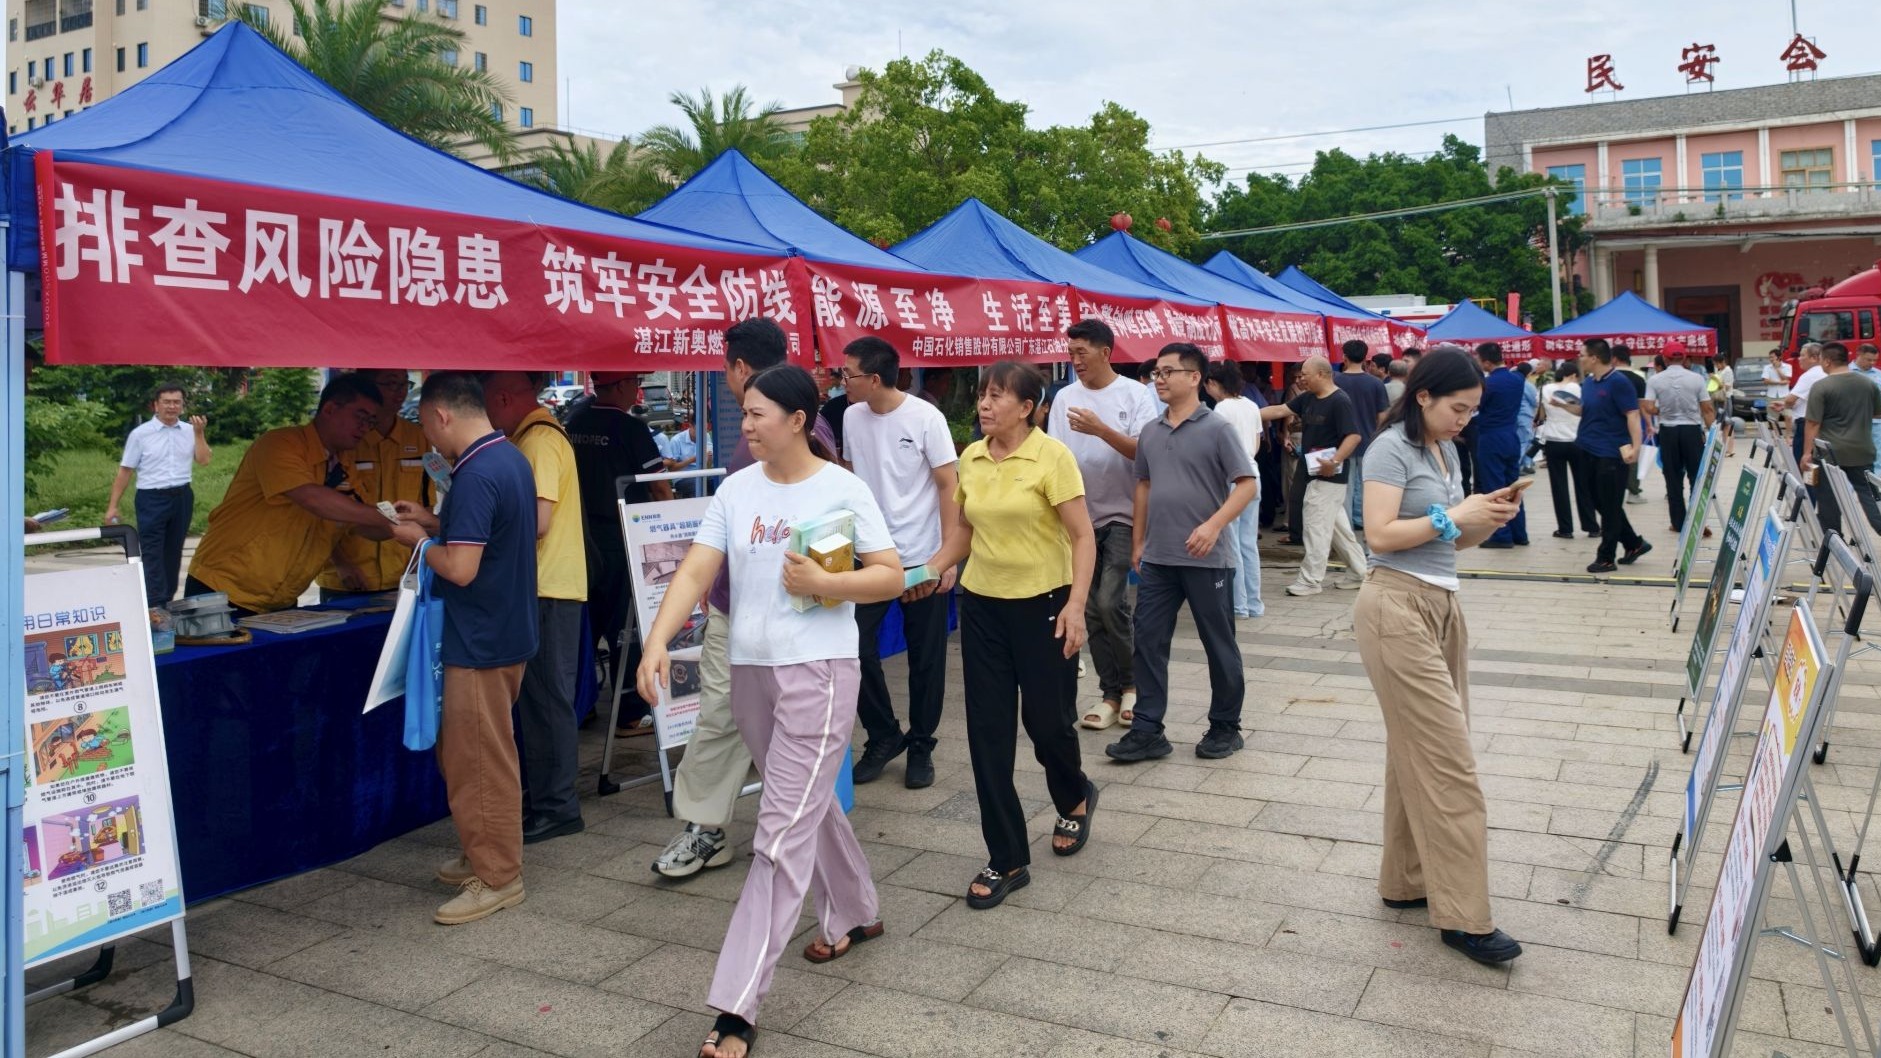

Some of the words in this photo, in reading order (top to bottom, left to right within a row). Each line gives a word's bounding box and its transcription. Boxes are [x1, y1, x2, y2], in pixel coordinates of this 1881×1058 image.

[54, 182, 509, 310] 排查风险隐患
[541, 241, 797, 325] 筑牢安全防线
[811, 274, 955, 332] 能源至净
[982, 290, 1072, 333] 生活至美
[912, 335, 1070, 358] 中国石化销售股份有限公司广东湛江石油分
